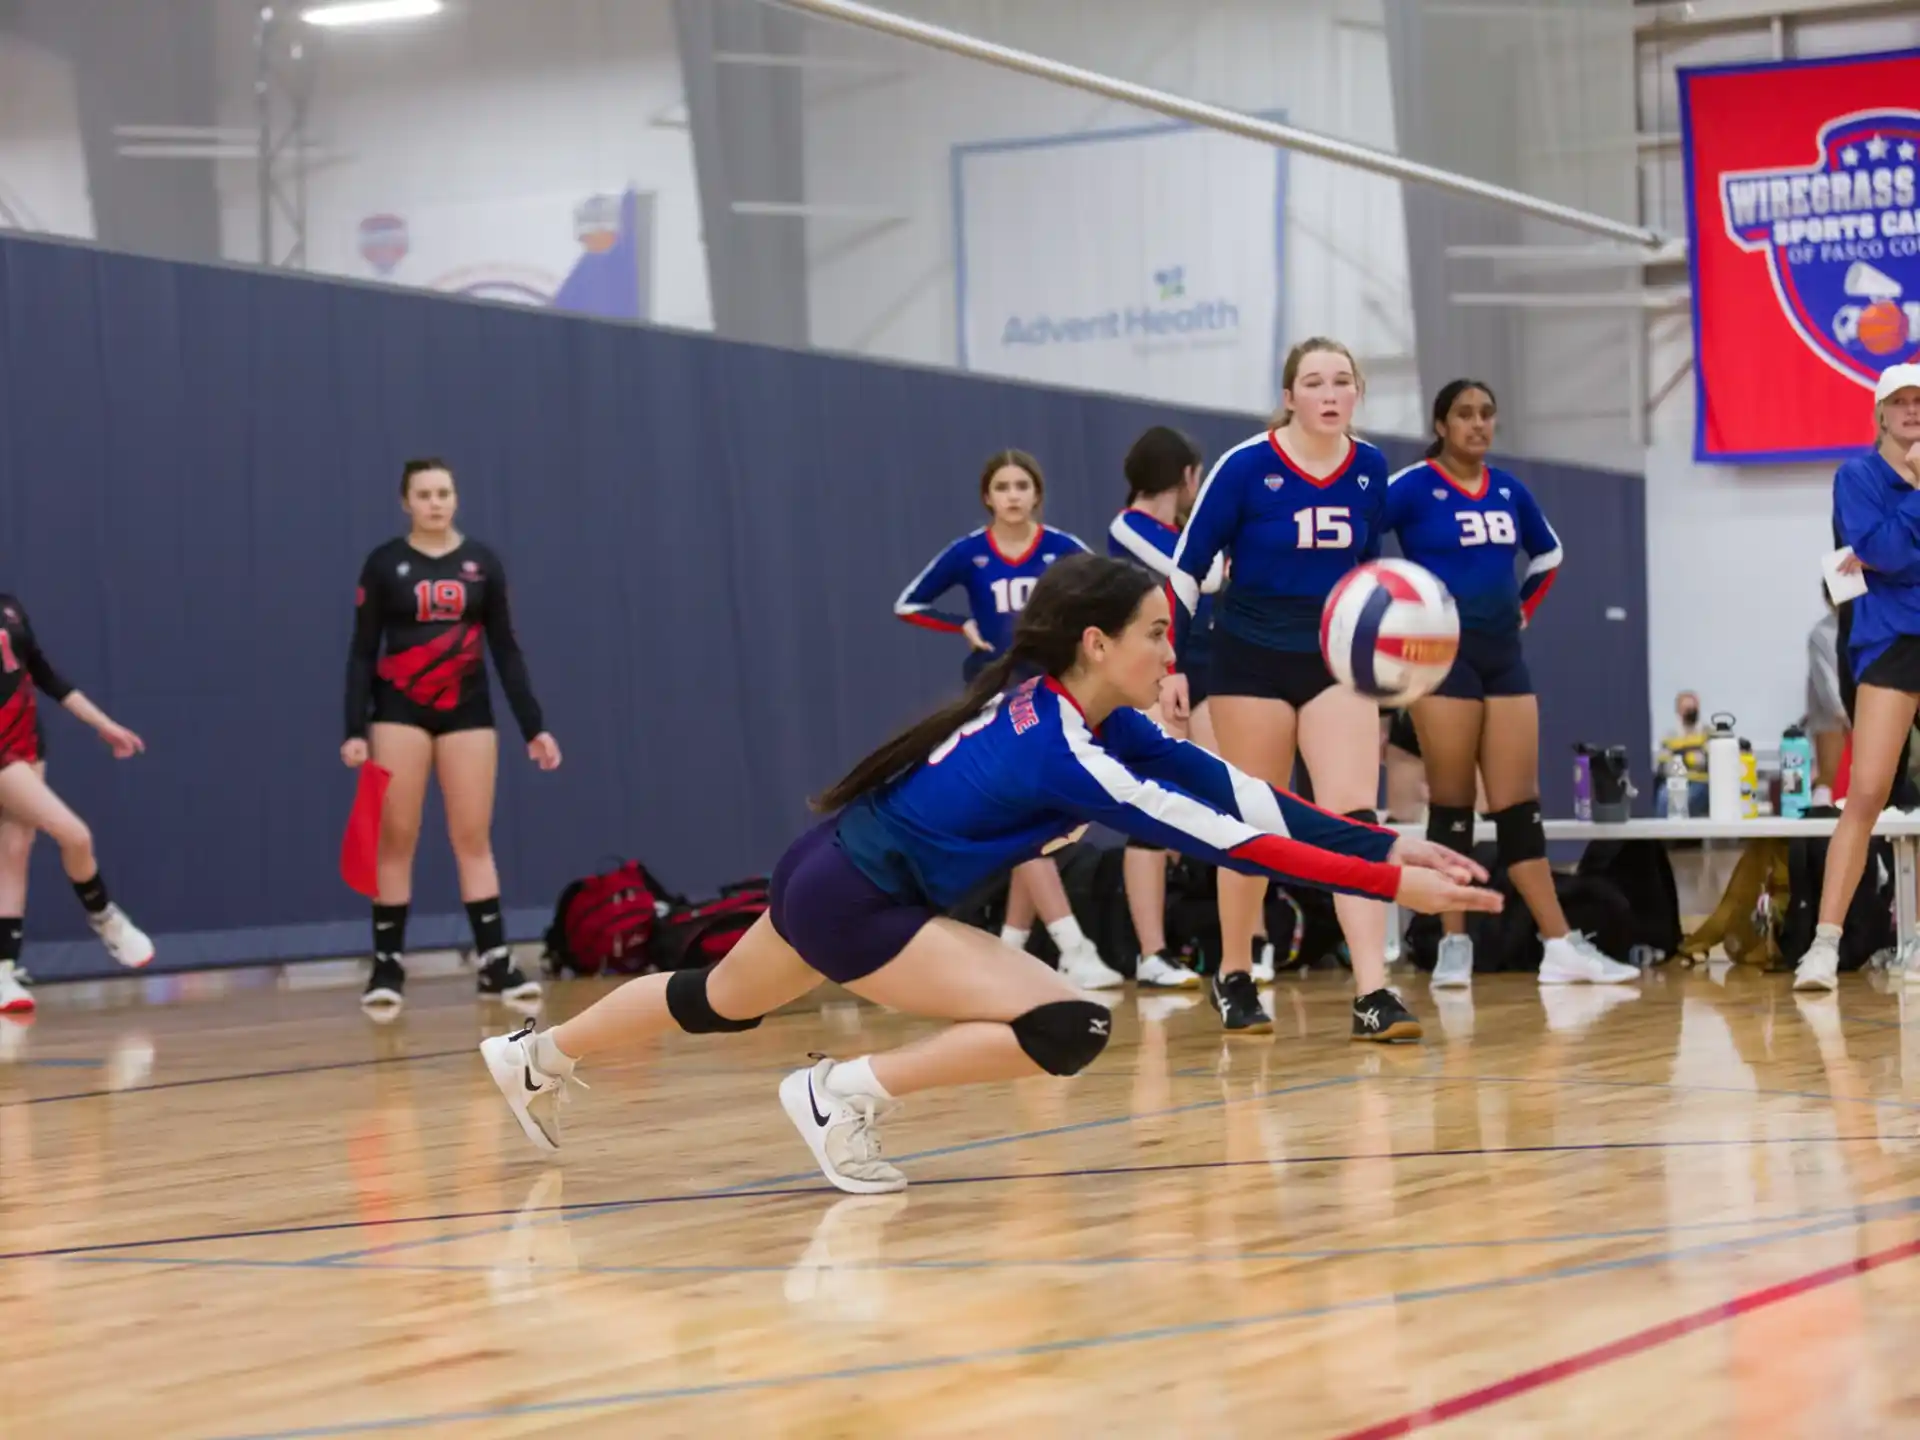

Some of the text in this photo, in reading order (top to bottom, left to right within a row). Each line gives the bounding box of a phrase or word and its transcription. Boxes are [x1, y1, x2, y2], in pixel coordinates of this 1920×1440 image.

[1729, 165, 1915, 226] WIREGRASS
[1772, 212, 1876, 245] SPORTS
[1787, 243, 1815, 265] OF
[1821, 239, 1884, 262] PASCO
[1293, 506, 1353, 549] 15
[1454, 510, 1517, 547] 38
[414, 579, 466, 621] 19
[990, 576, 1039, 613] 10
